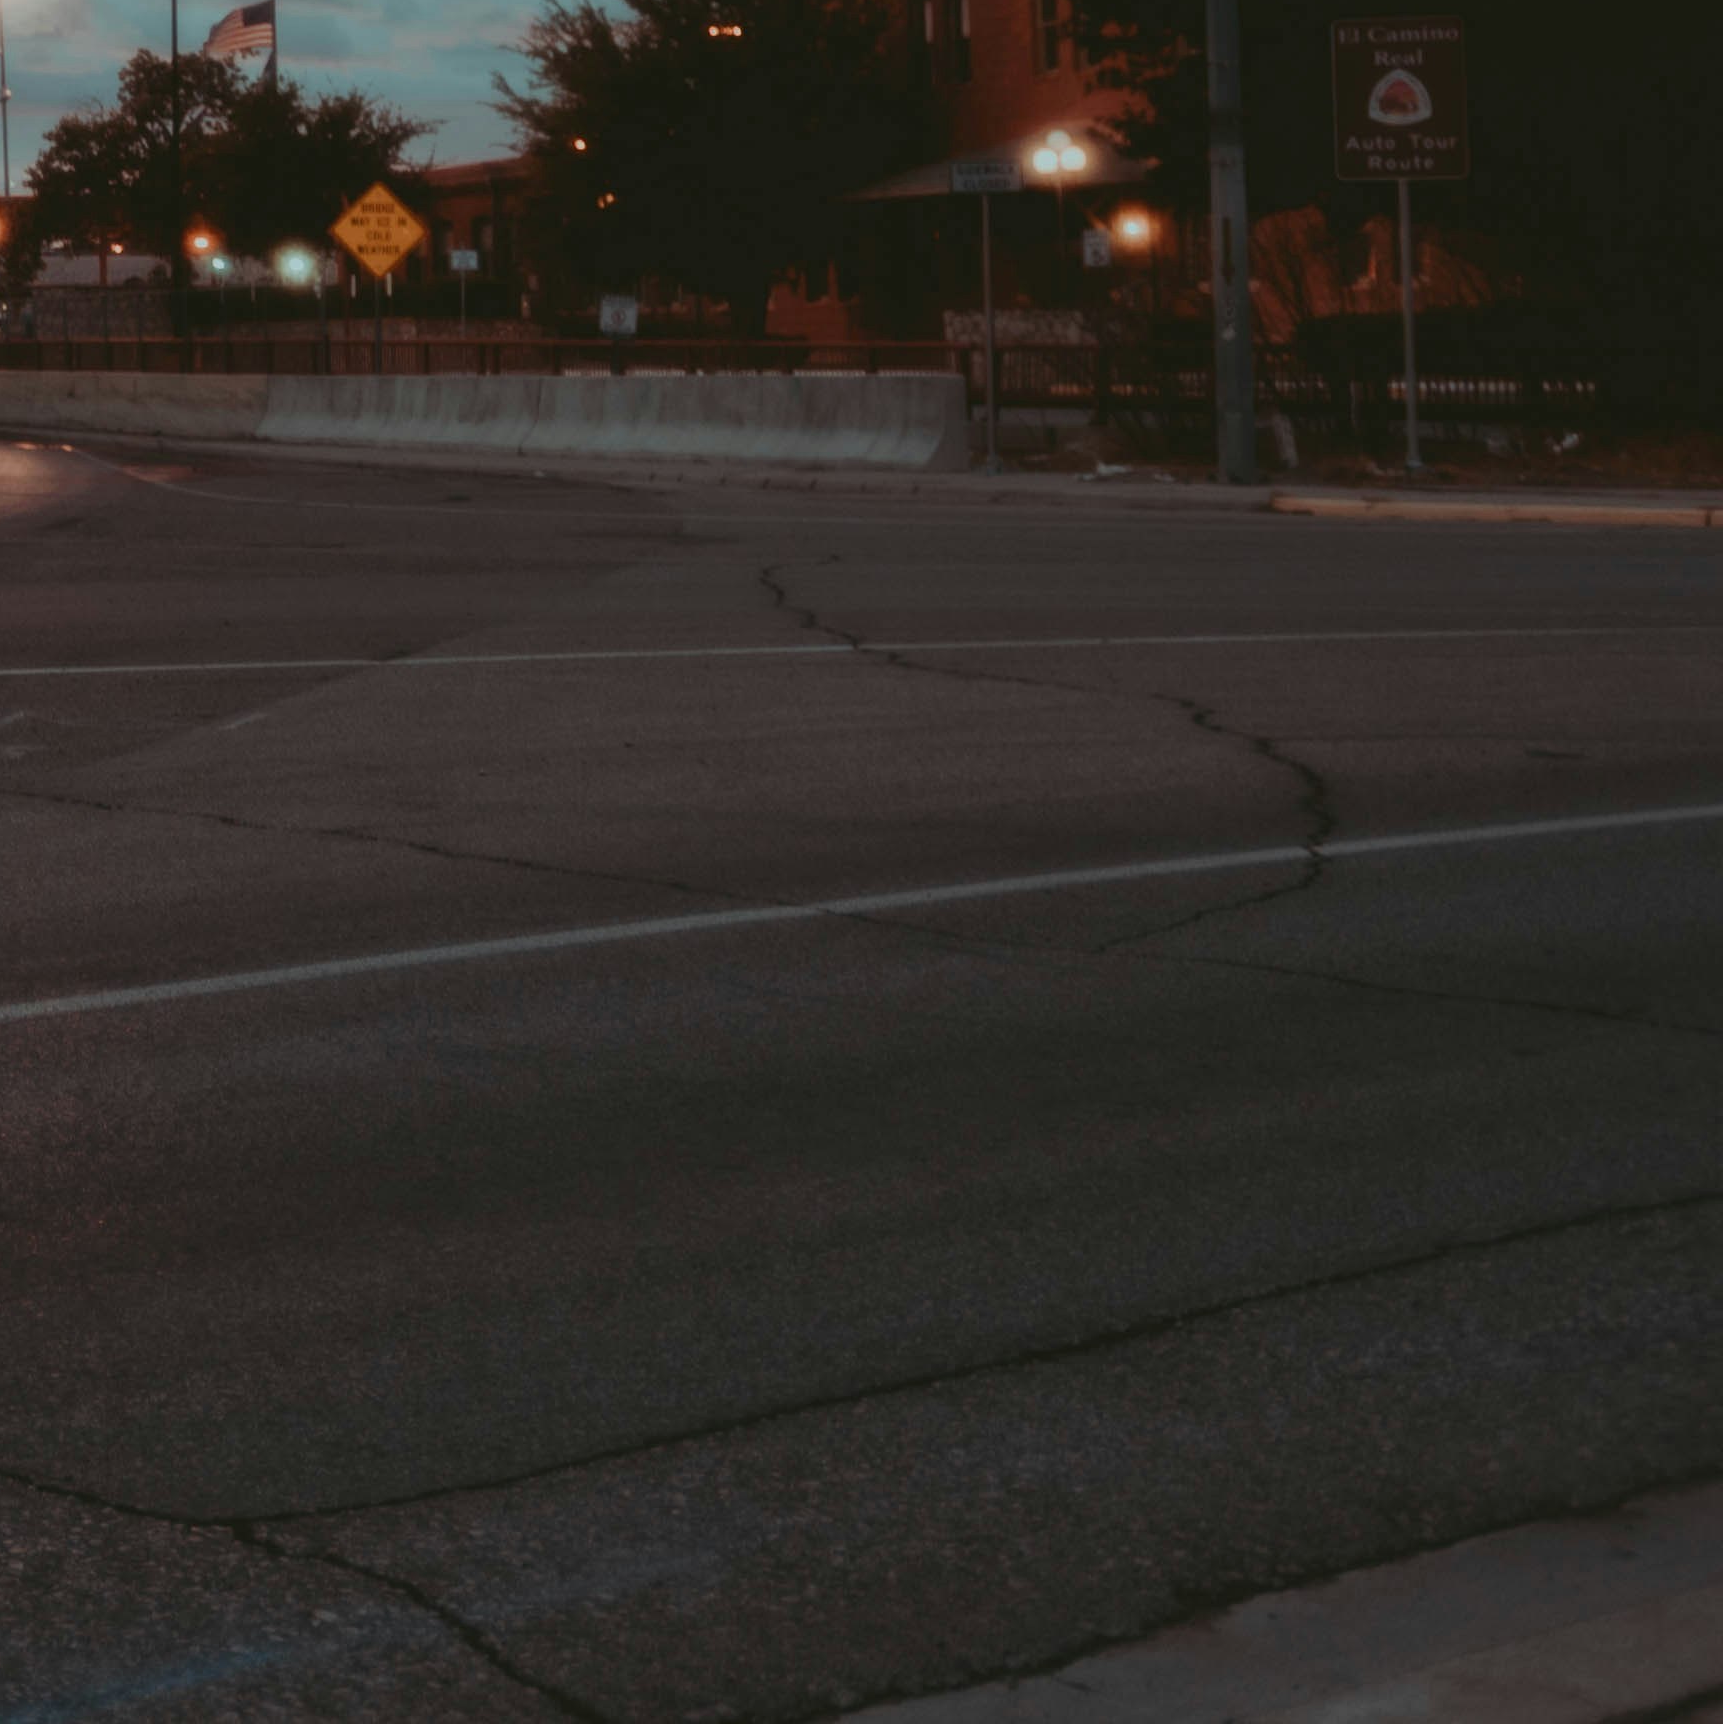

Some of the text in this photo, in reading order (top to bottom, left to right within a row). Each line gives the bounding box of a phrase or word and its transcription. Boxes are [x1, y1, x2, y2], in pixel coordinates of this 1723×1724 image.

[1338, 25, 1460, 45] El Camino
[1374, 49, 1424, 67] Real
[1346, 133, 1458, 150] Auto Tour
[1368, 156, 1435, 171] Route
[362, 203, 396, 213] BRIDGE
[351, 217, 370, 226] MAY
[365, 230, 392, 241] COLD
[357, 245, 400, 254] WEATHER
